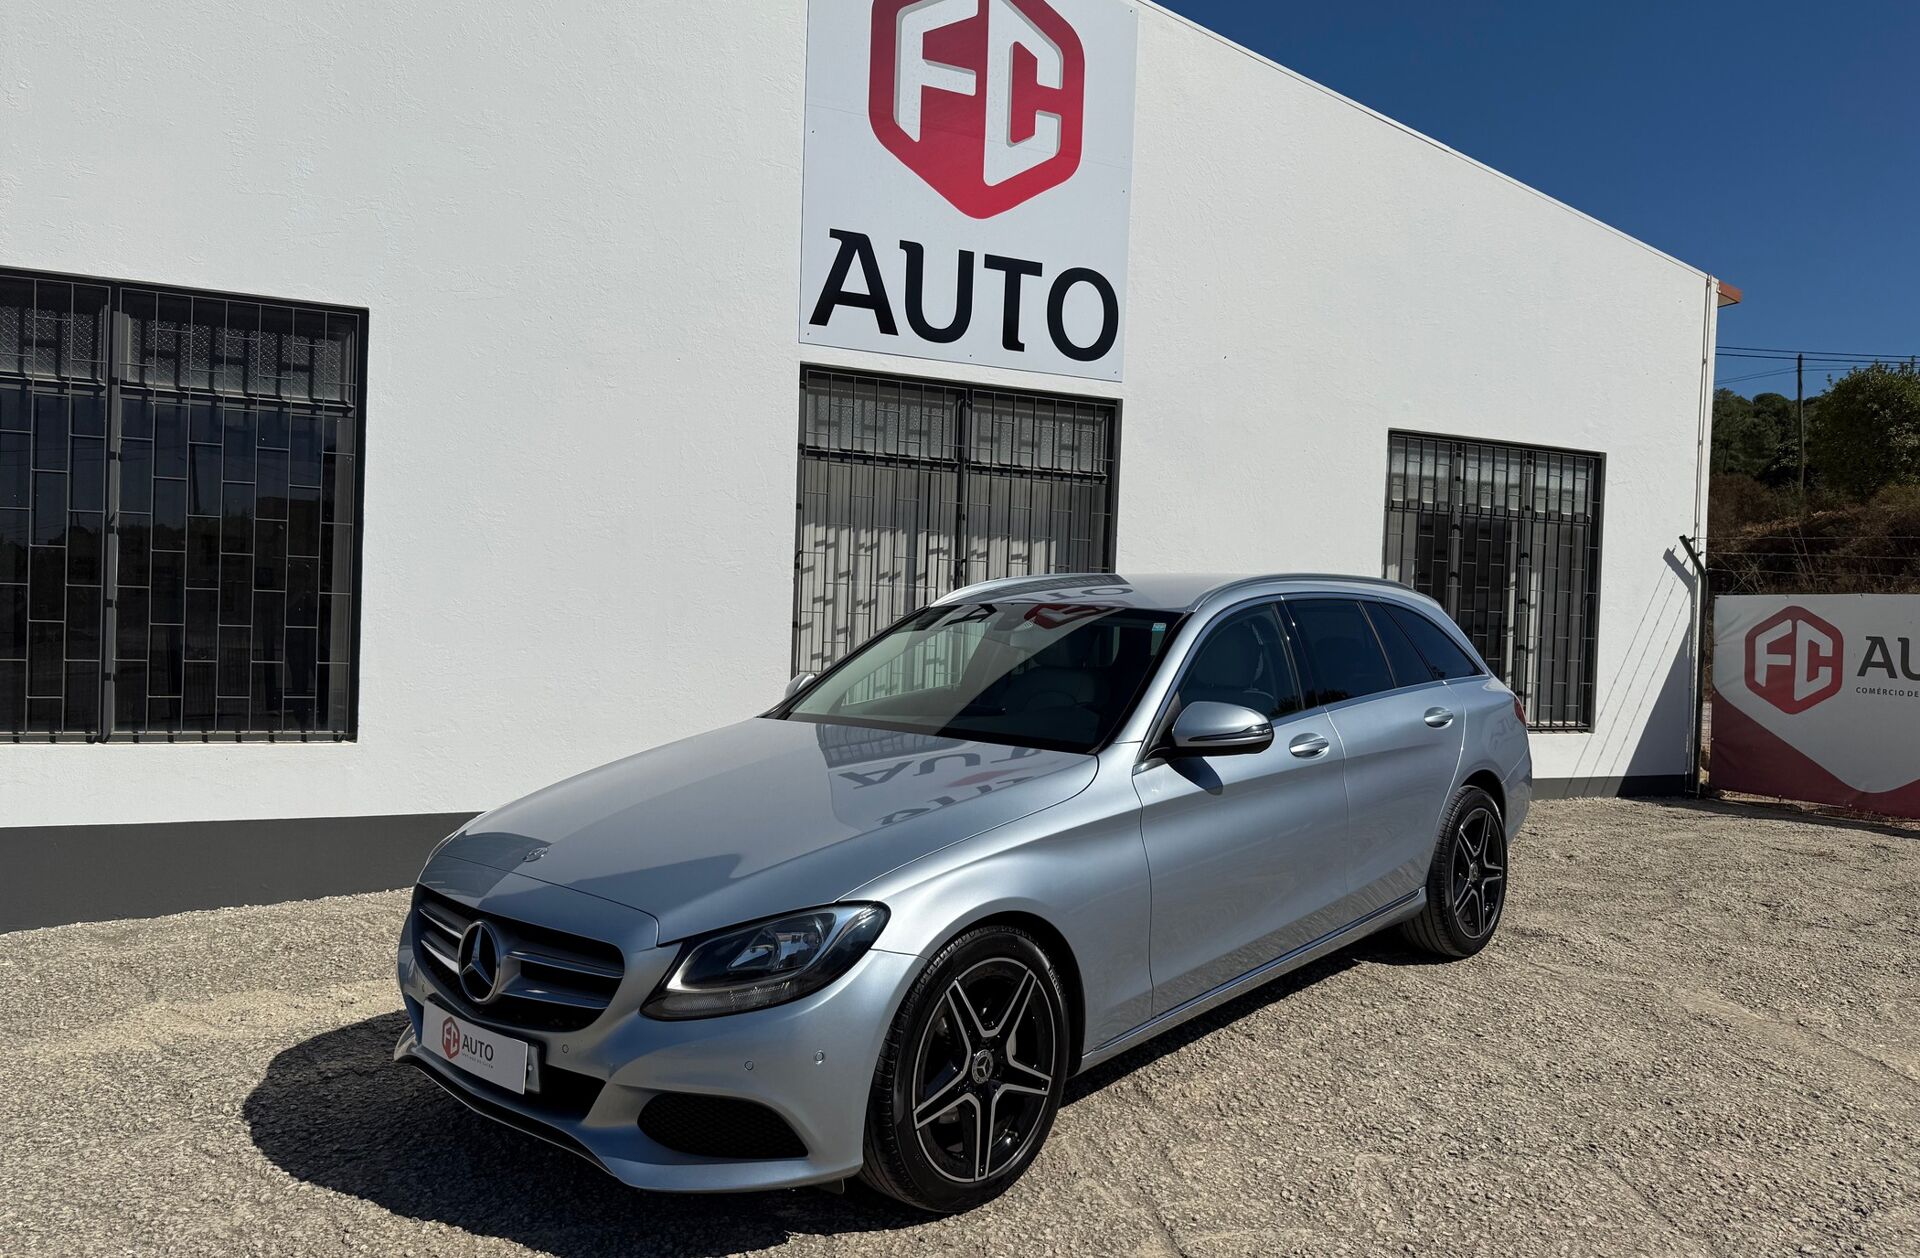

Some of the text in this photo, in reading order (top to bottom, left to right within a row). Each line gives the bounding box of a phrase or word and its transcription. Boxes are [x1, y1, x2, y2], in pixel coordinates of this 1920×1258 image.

[892, 0, 1064, 187] FC
[808, 228, 1119, 362] AUTO
[1754, 619, 1834, 702] FC
[1855, 686, 1919, 698] COMÉRCIO DE
[443, 1022, 459, 1056] FC
[461, 1033, 494, 1062] AUTO
